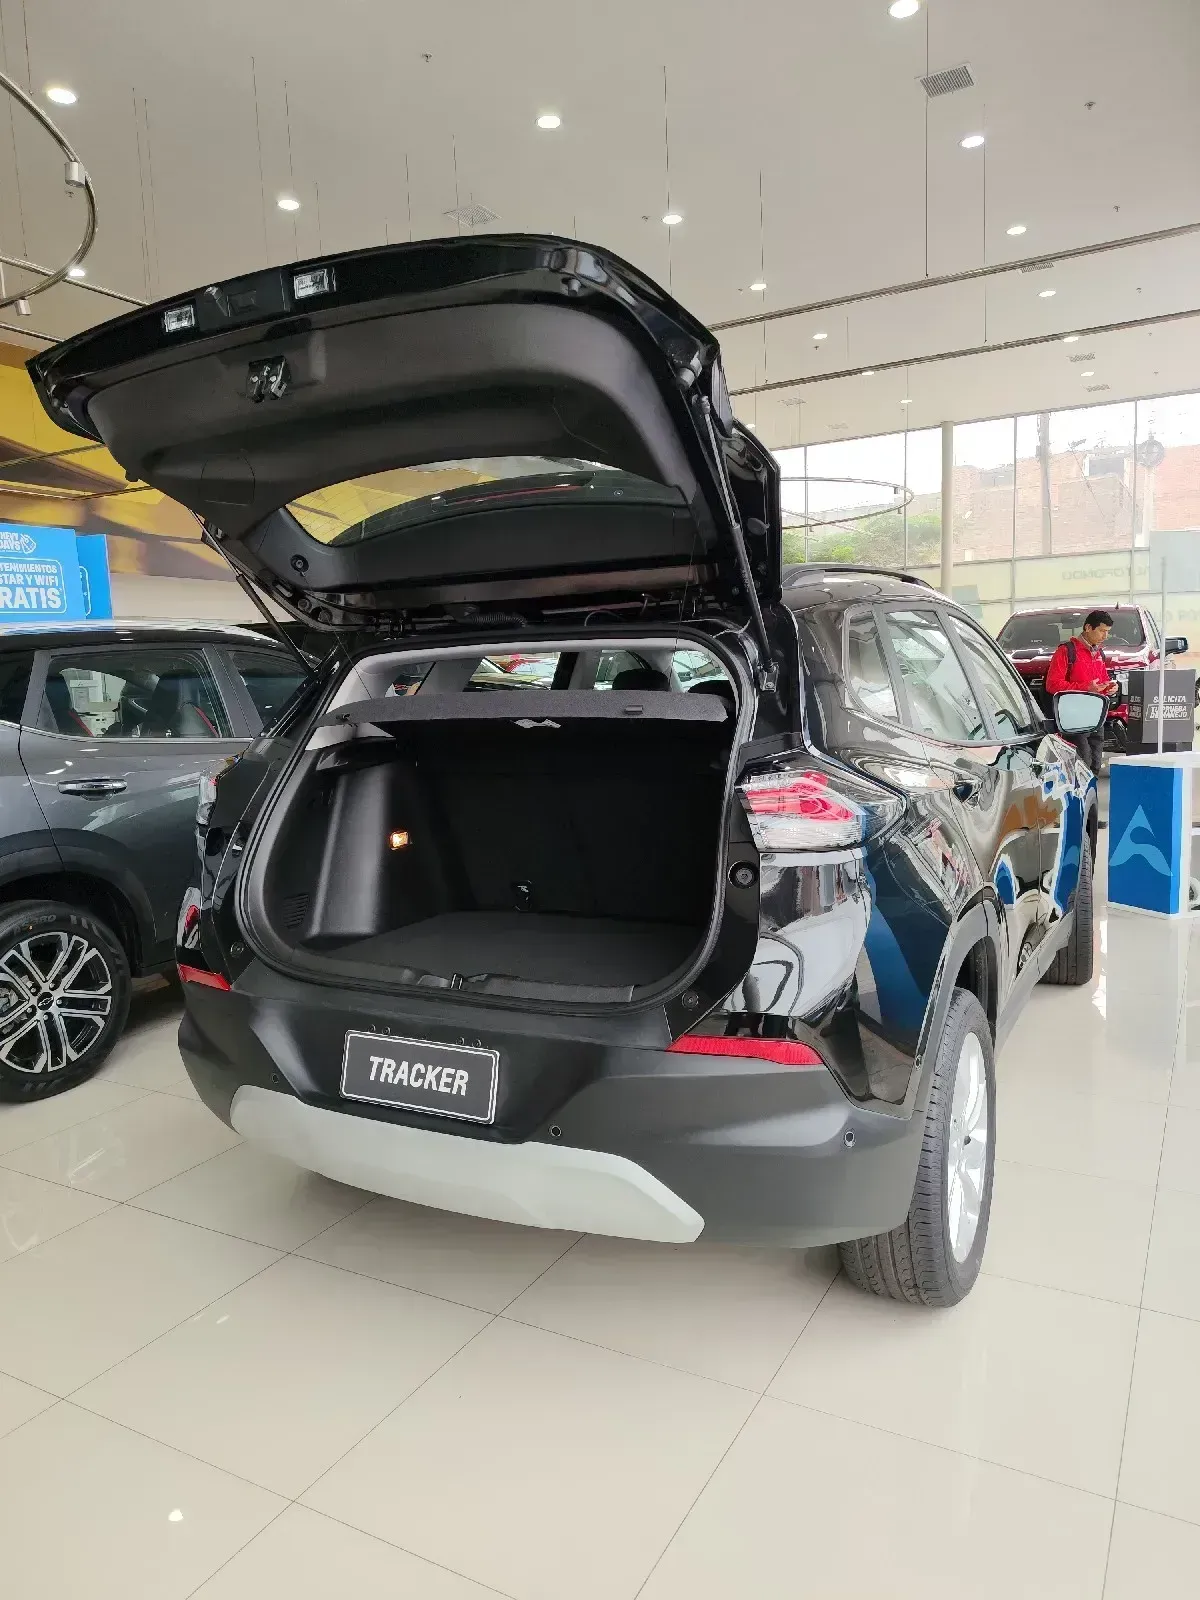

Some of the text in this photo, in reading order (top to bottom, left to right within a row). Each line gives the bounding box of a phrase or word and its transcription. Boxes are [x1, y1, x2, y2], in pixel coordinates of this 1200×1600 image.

[25, 574, 33, 586] Y
[34, 575, 59, 587] WIFI
[1153, 695, 1186, 703] SLICITA
[369, 1056, 469, 1096] TRACKER
